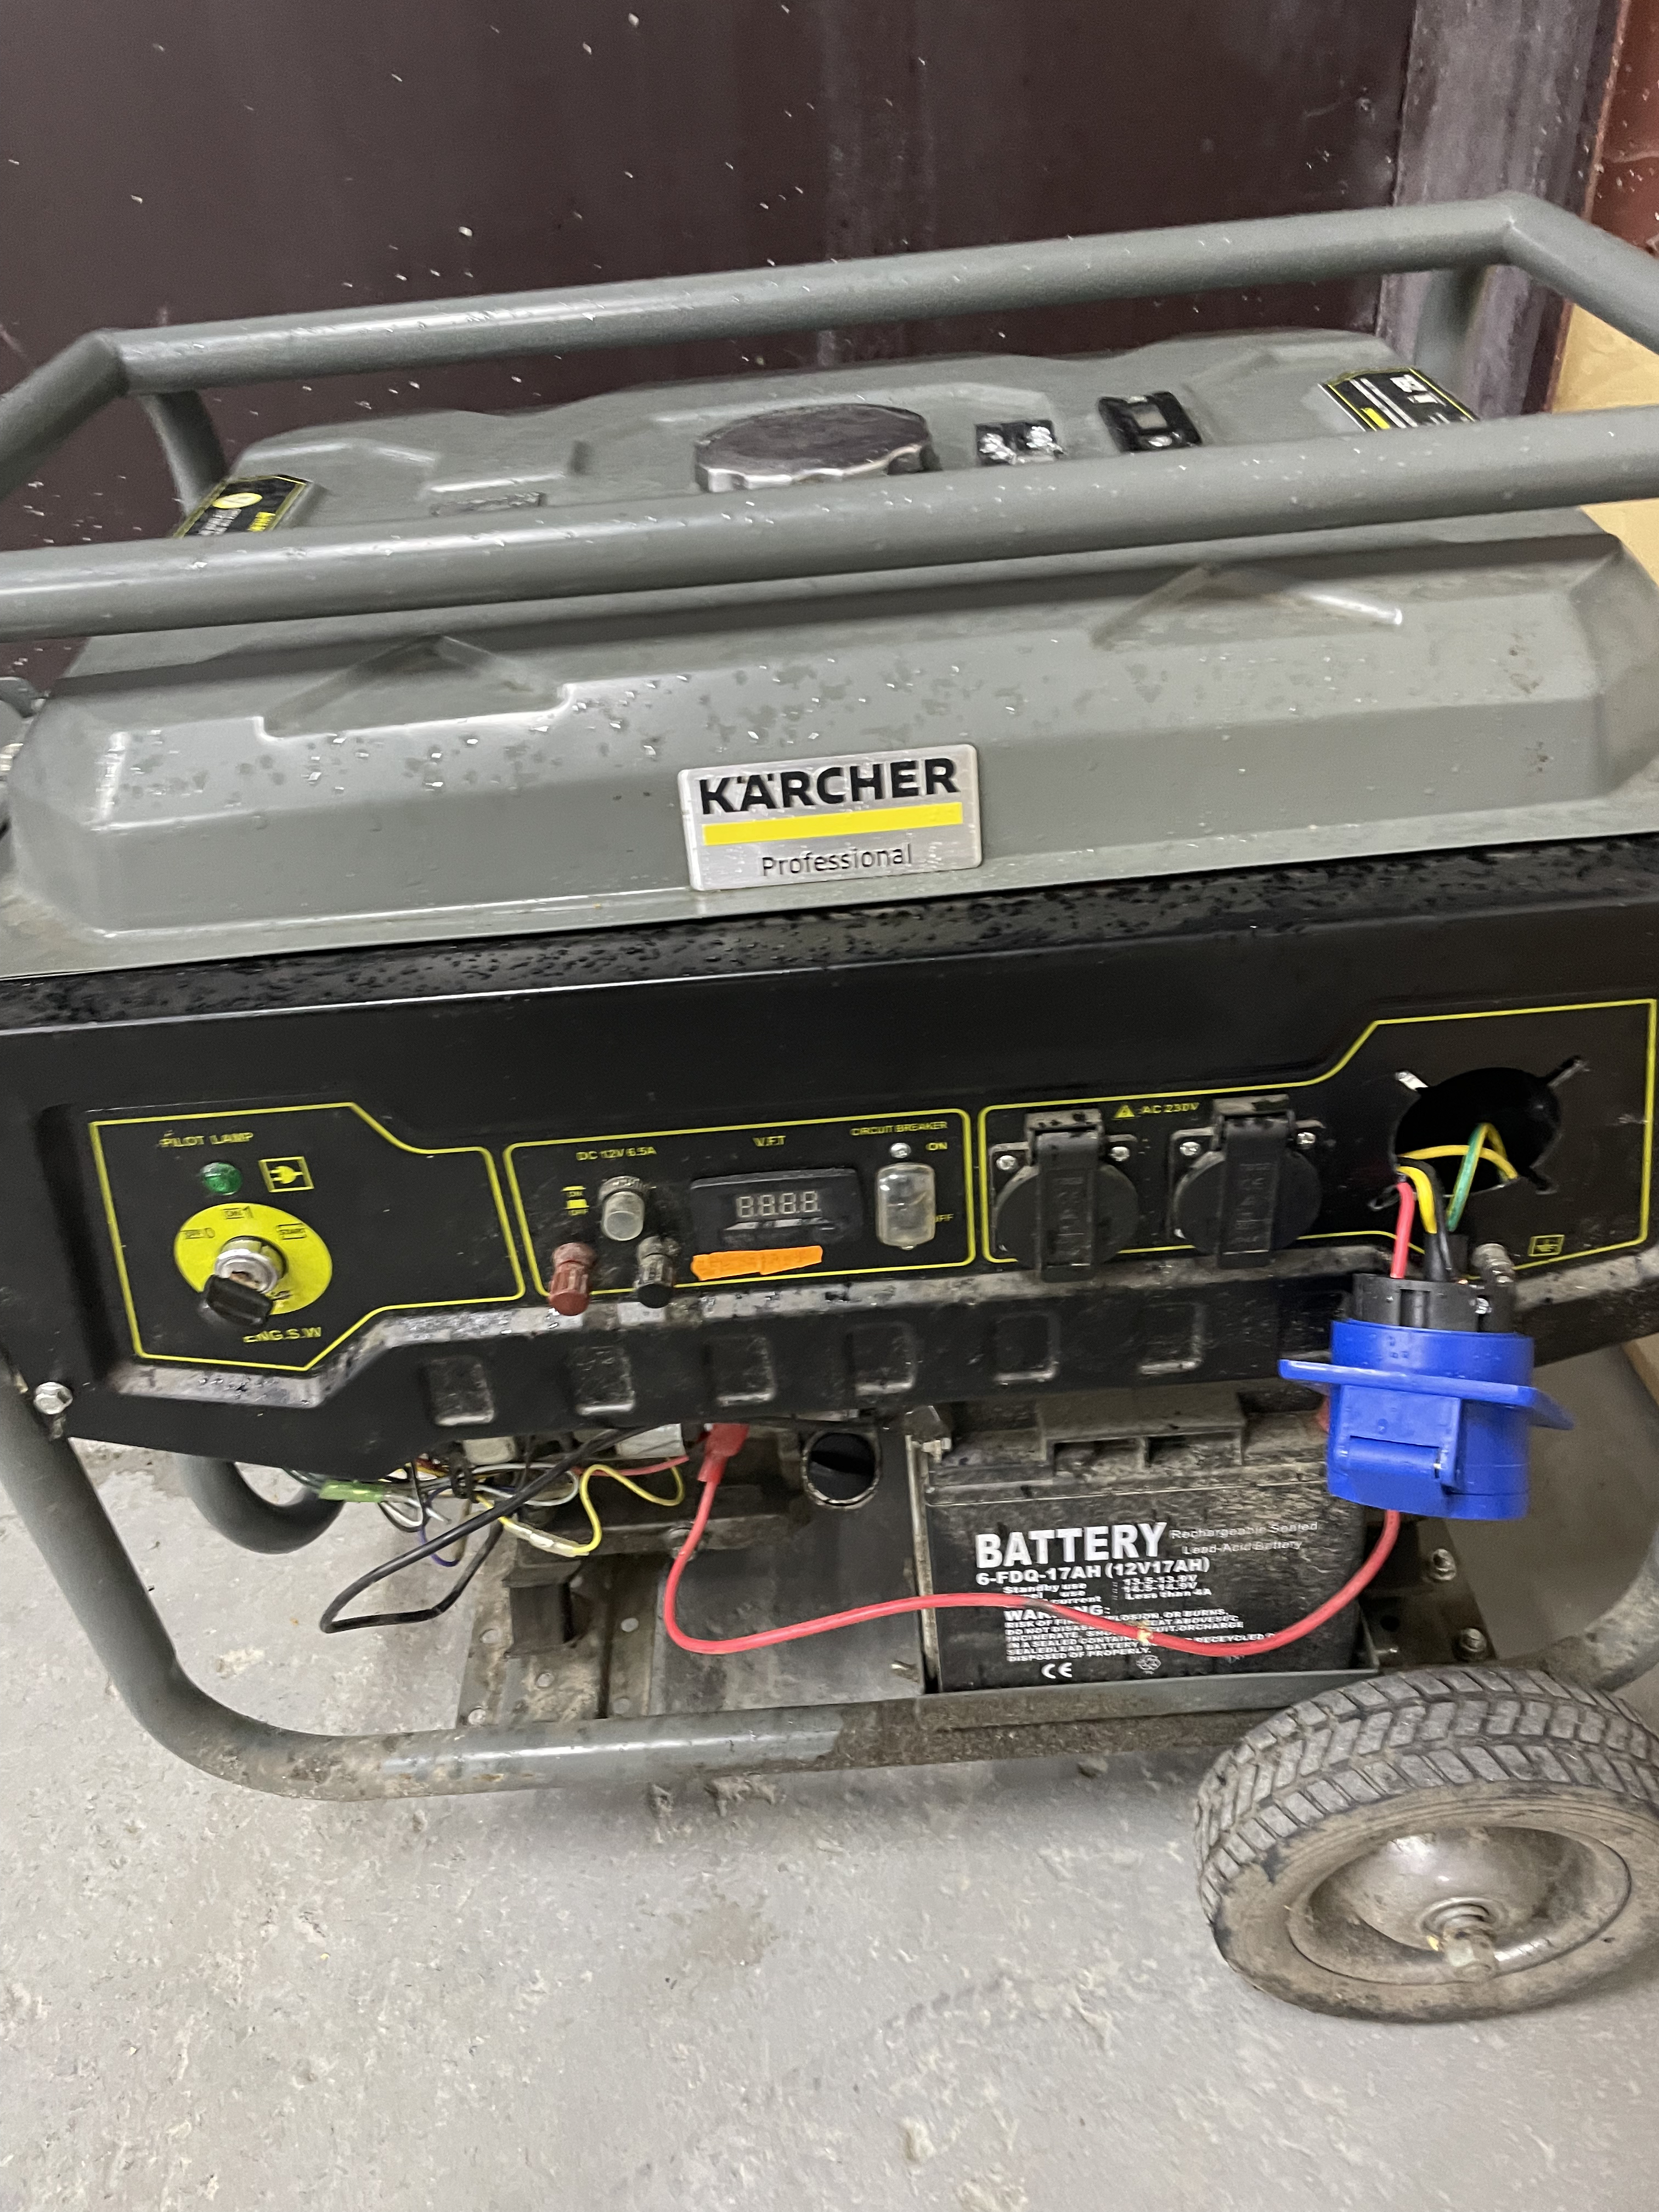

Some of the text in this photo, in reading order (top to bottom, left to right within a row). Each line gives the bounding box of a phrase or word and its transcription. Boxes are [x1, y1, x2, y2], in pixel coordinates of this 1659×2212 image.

[699, 758, 961, 815] KÄRCHER
[761, 843, 912, 877] Professional
[1141, 1105, 1162, 1114] AC
[850, 1121, 948, 1136] CIRCUIT BREAKER
[159, 1132, 253, 1148] PILOT LAMP
[926, 1142, 948, 1151] ON
[576, 1151, 598, 1161] DC
[1169, 1521, 1318, 1539] Rechargeable Sealed
[975, 1521, 1167, 1568] BATTERY
[975, 1556, 1210, 1586] 6-FDQ-17AH (12V17AH)
[1003, 1584, 1060, 1594] Standby
[1125, 1592, 1158, 1600] Less
[1005, 1620, 1036, 1629] RISK
[1024, 1626, 1050, 1634] NOT
[1031, 1639, 1077, 1647] SEALED
[1084, 1641, 1139, 1650] BATTERY
[1006, 1652, 1067, 1662] DISPOSED
